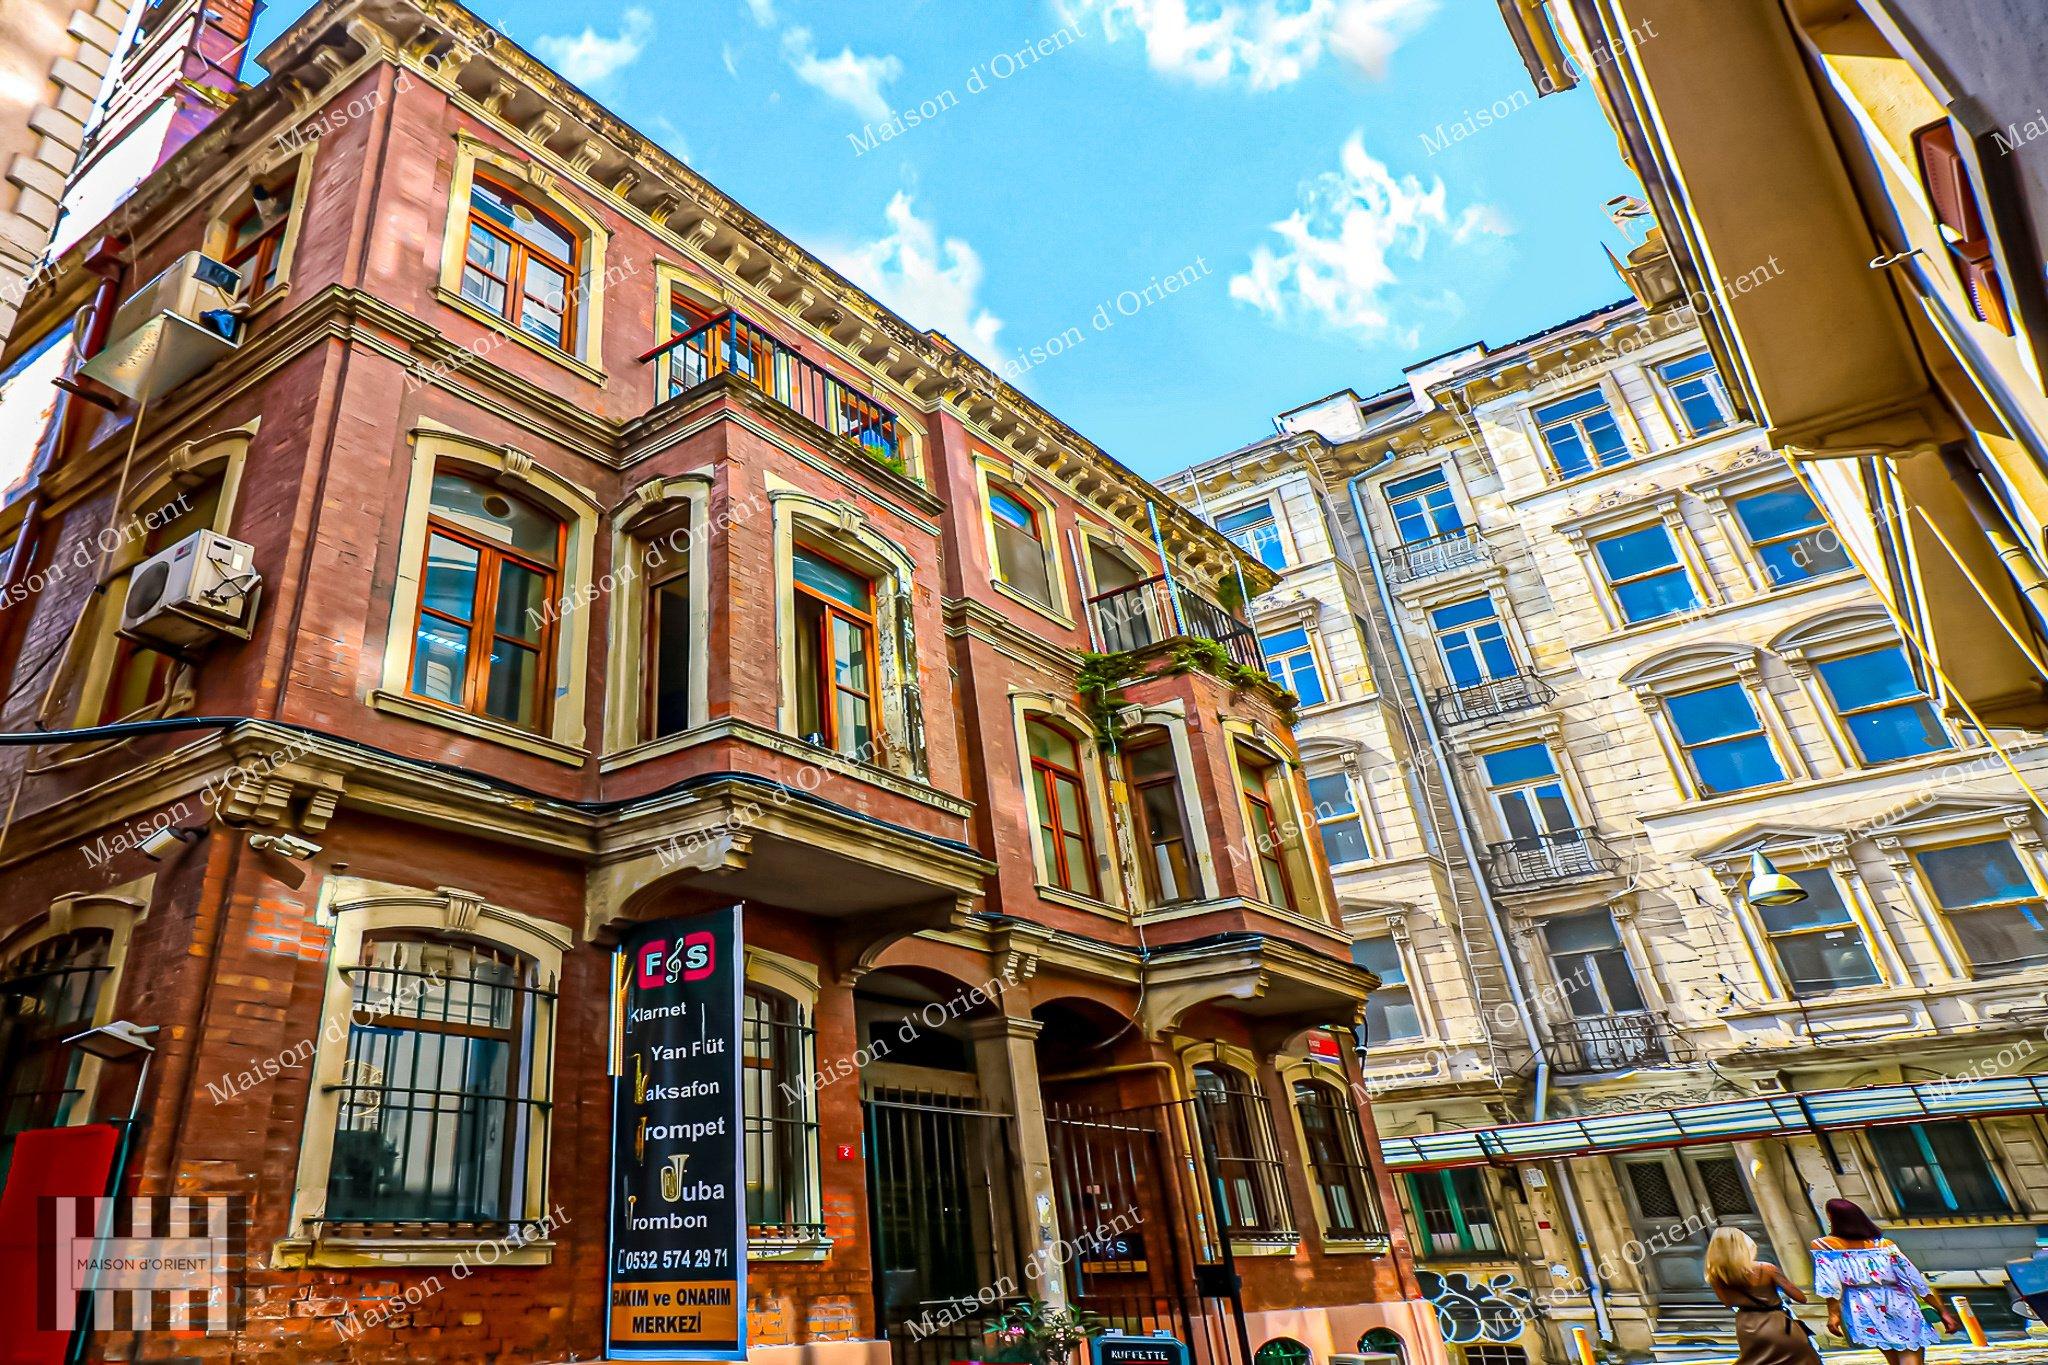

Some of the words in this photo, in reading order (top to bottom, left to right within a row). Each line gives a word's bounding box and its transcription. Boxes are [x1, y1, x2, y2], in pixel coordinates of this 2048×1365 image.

[645, 952, 662, 976] F
[686, 944, 708, 970] S
[651, 1044, 686, 1061] Yan
[625, 1251, 658, 1269] 0532
[662, 1250, 691, 1269] 574
[695, 1249, 711, 1268] 29
[714, 1248, 728, 1267] 71
[612, 1289, 648, 1307] BAKIM
[653, 1294, 671, 1305] ve
[676, 1288, 730, 1306] ONARIM
